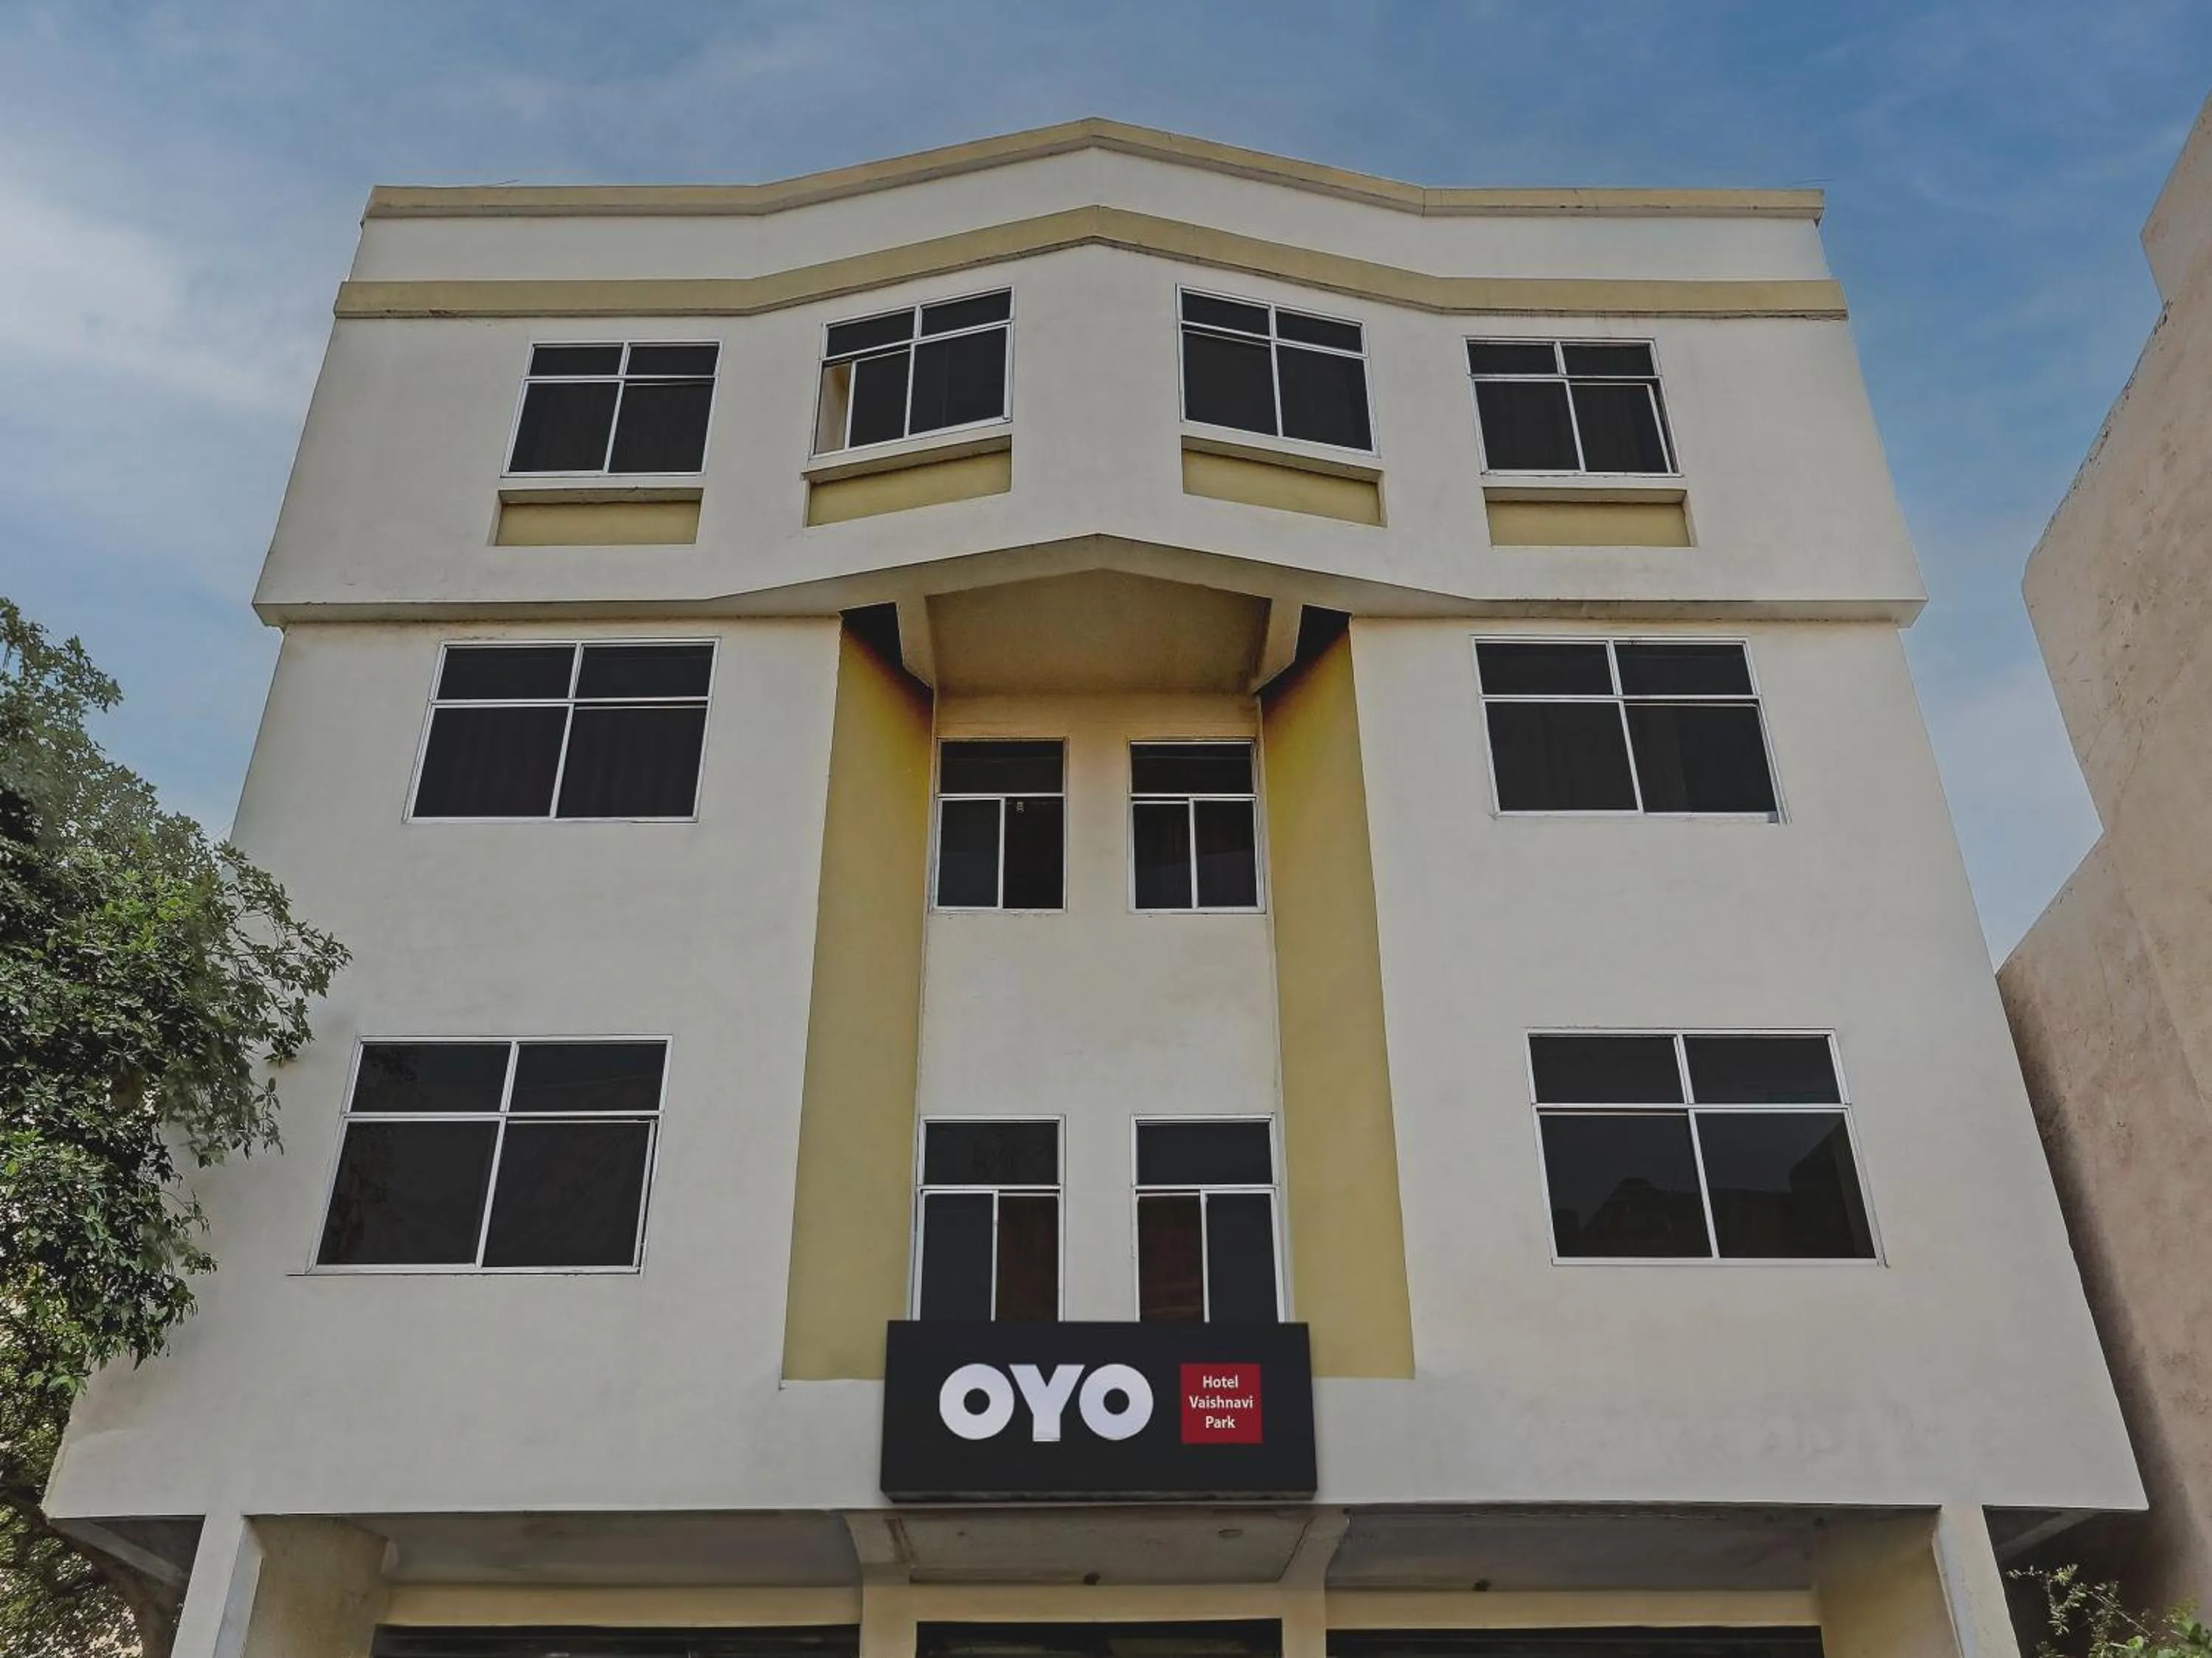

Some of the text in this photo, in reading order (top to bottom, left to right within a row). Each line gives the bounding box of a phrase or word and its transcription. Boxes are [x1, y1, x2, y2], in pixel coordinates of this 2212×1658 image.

[1203, 1375, 1239, 1388] Hotel
[939, 1364, 1154, 1442] OYO
[1189, 1395, 1253, 1409] Vaishnavi
[1205, 1415, 1236, 1429] Park
